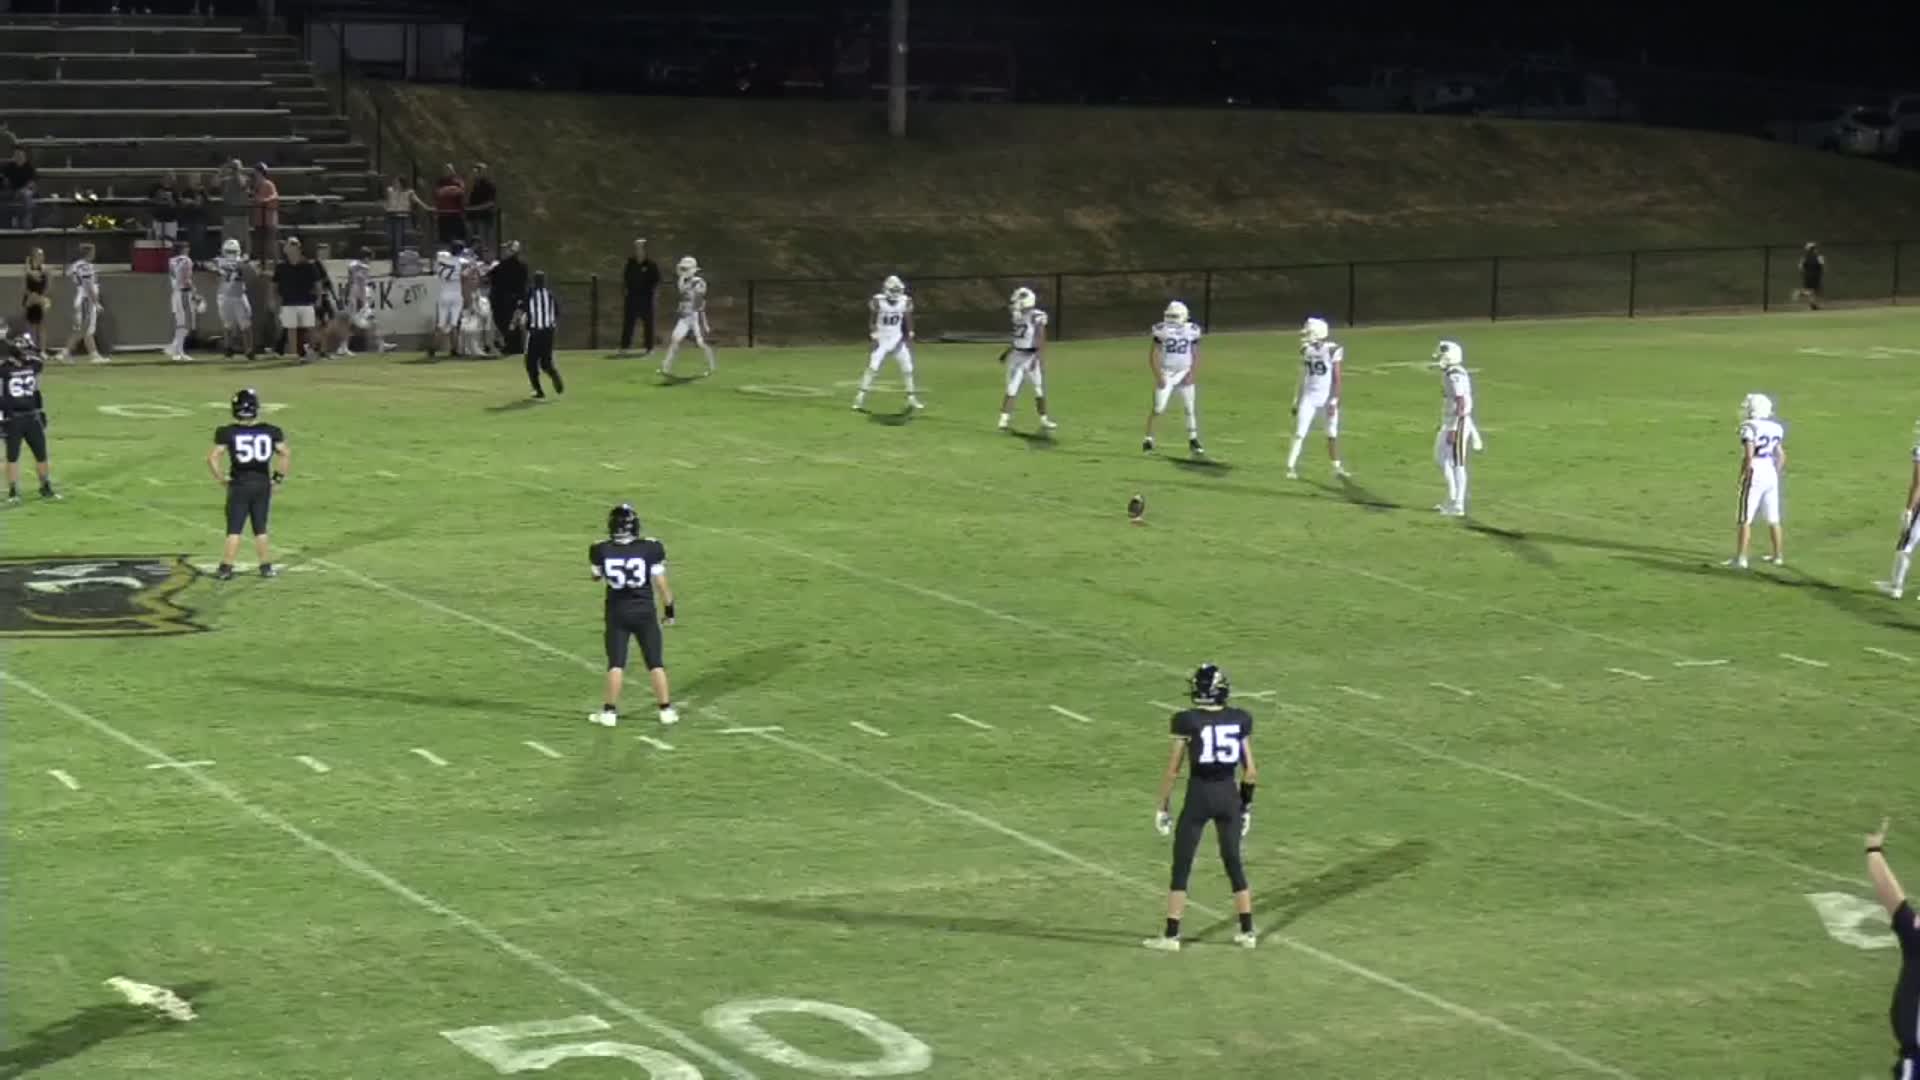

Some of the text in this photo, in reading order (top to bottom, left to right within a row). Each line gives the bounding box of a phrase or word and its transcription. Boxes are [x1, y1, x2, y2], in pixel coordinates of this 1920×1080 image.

[1165, 338, 1189, 354] 22
[1304, 360, 1327, 376] 19
[235, 433, 272, 463] 50
[604, 557, 646, 590] 53
[1199, 724, 1241, 763] 15
